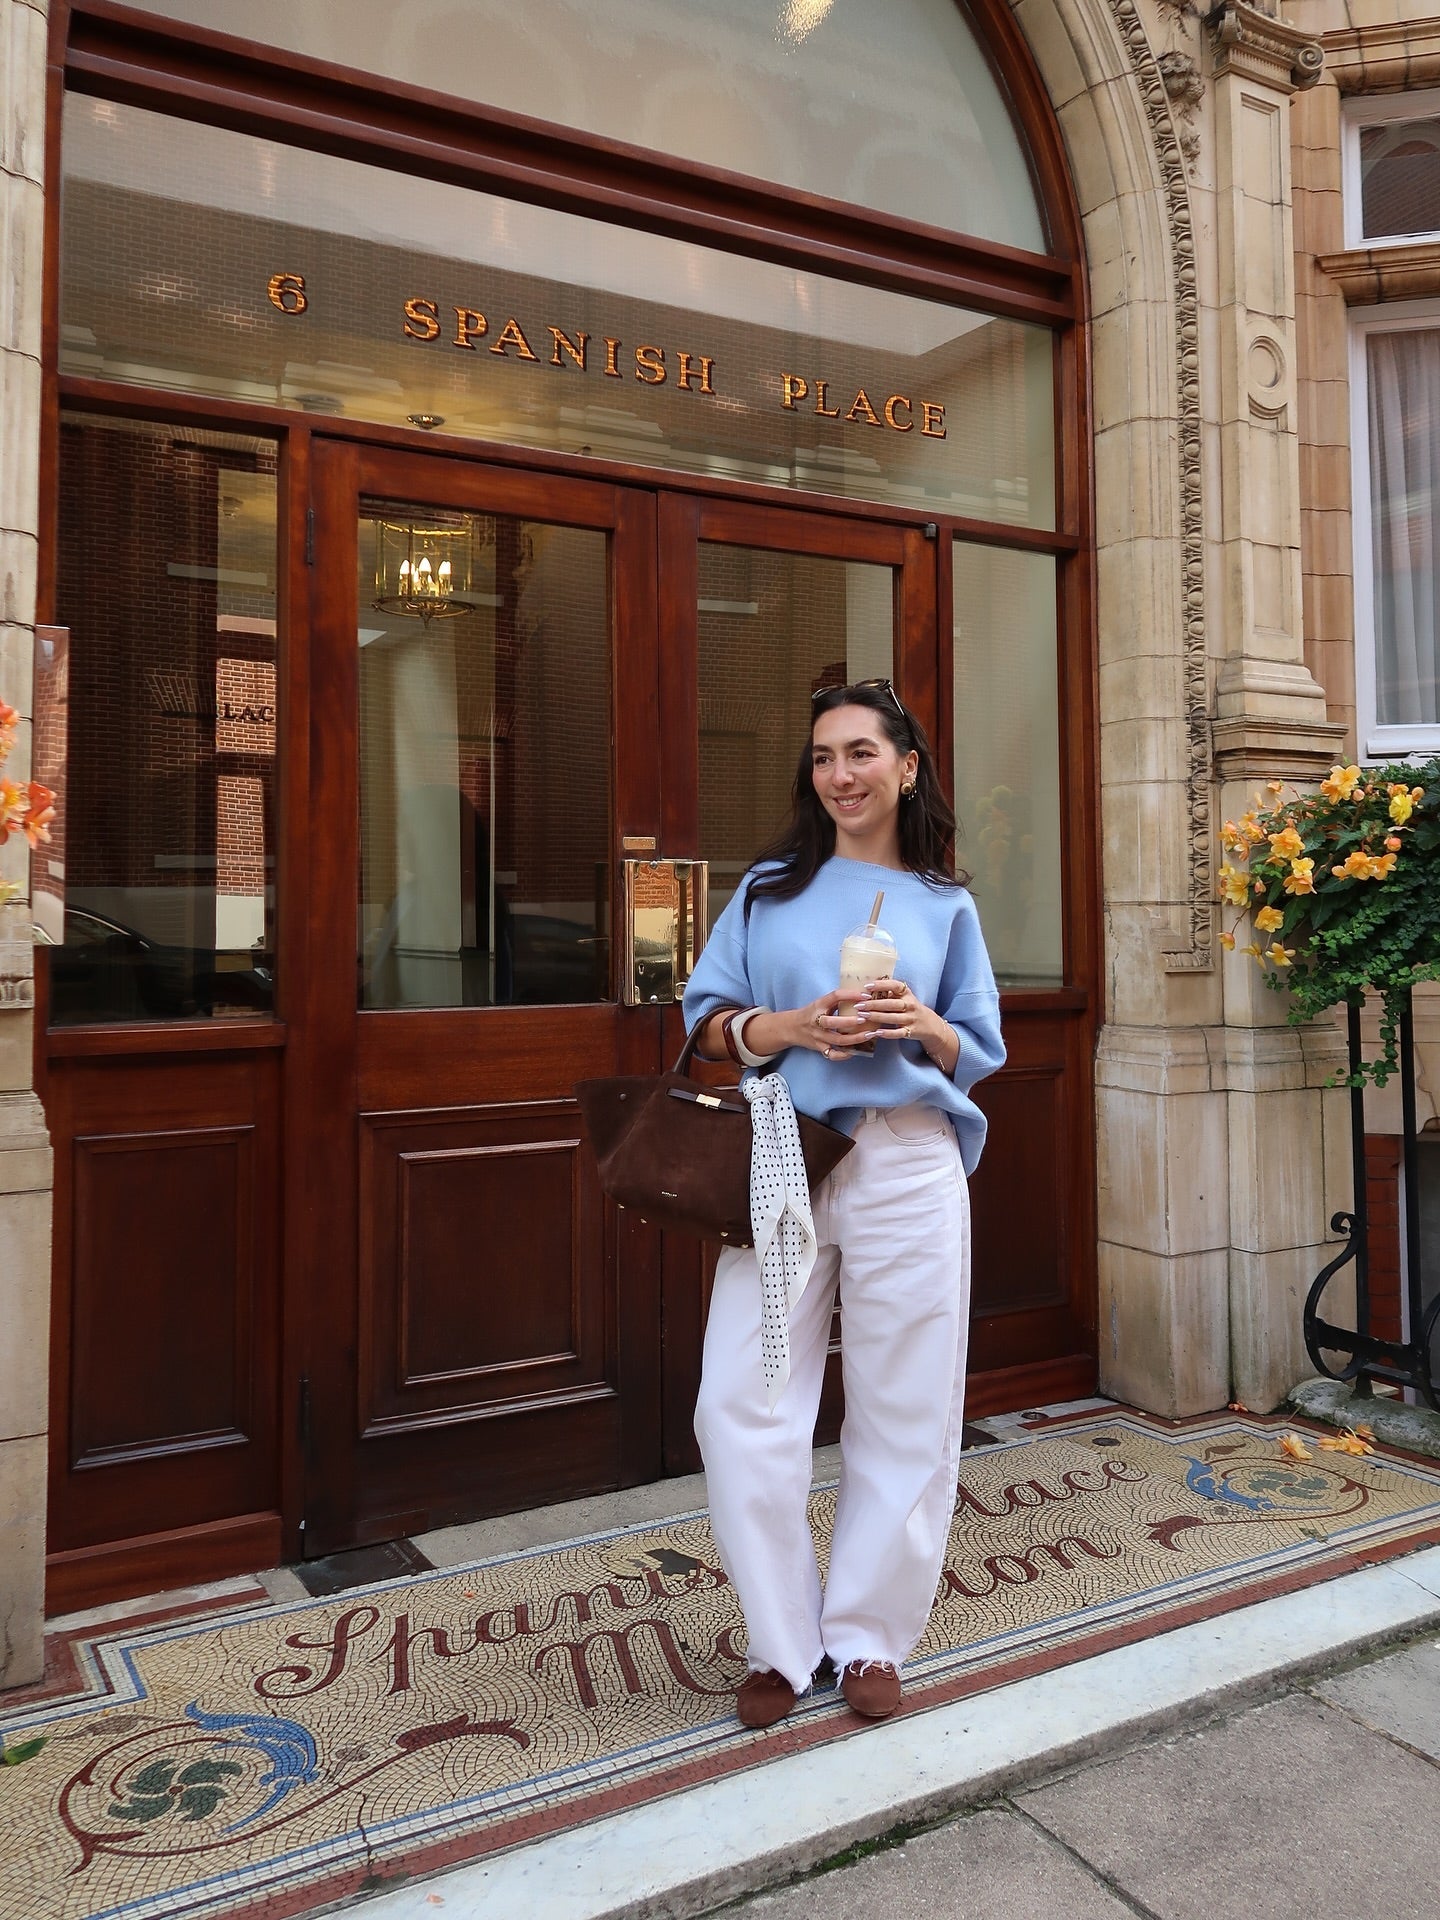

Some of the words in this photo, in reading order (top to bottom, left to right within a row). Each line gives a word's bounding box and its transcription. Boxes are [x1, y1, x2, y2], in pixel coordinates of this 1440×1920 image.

[267, 272, 308, 315] 6
[403, 297, 716, 396] SPANISH
[780, 372, 948, 439] PLACE
[223, 702, 275, 722] LAC
[254, 1559, 729, 1699] Spanis
[952, 1459, 1149, 1517] lace
